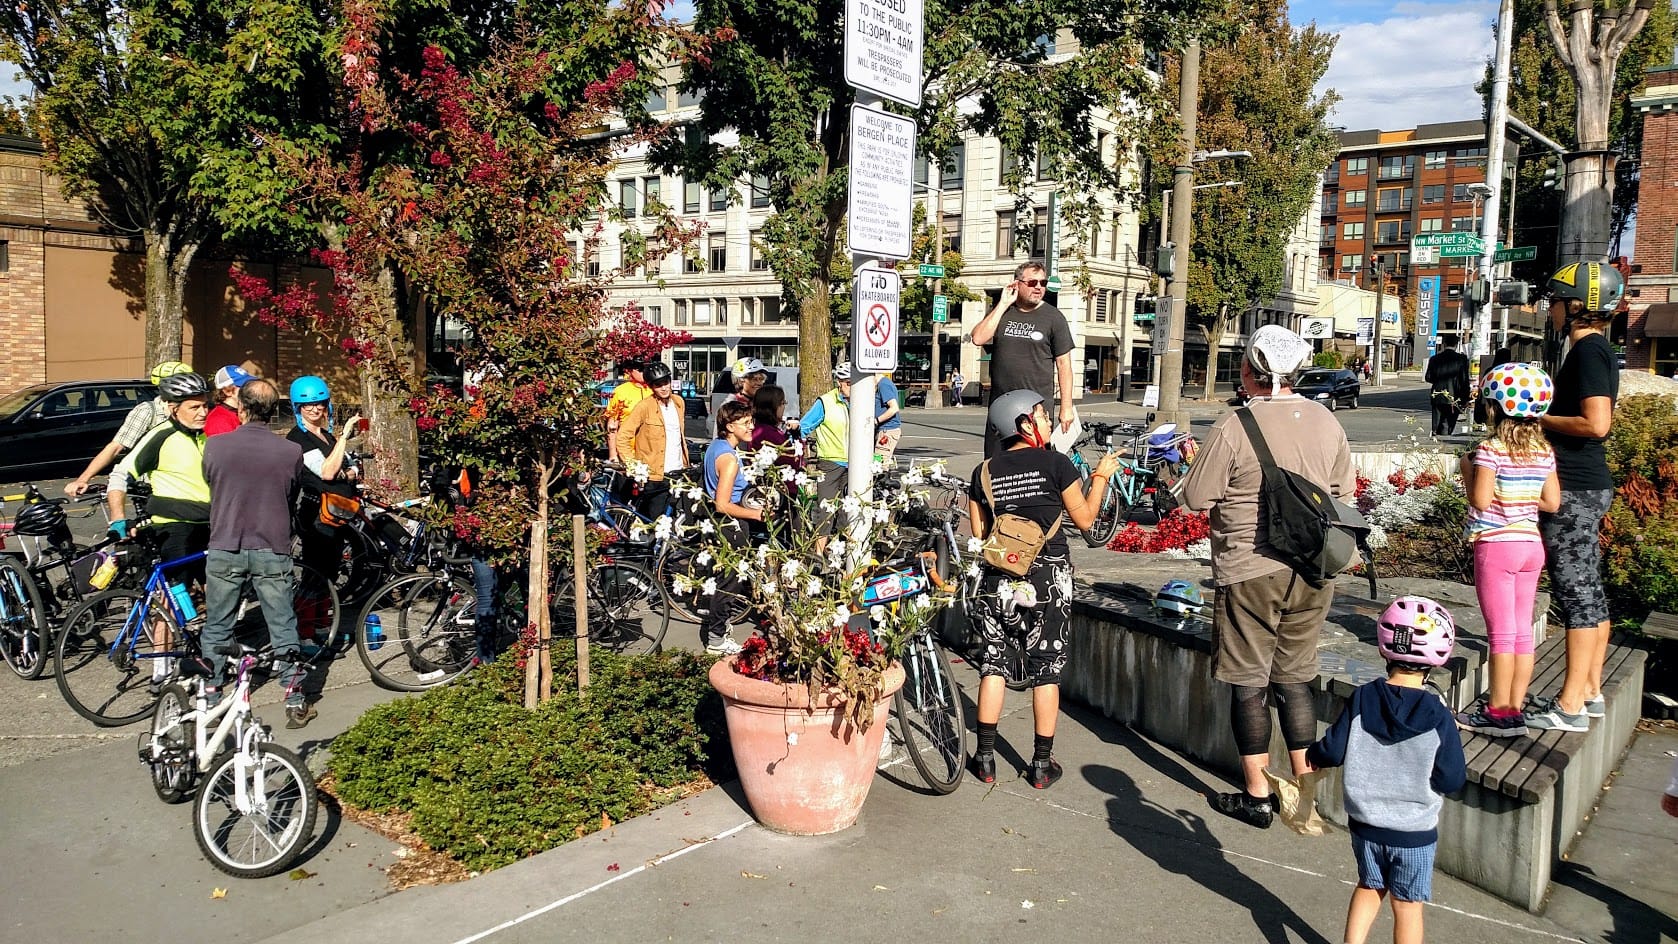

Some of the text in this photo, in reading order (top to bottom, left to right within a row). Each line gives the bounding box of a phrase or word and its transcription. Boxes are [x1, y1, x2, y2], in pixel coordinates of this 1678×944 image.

[875, 0, 906, 14] SED
[860, 2, 912, 35] TO THE PUBLIC
[857, 18, 891, 44] 11:30PM
[897, 35, 913, 53] 4AM
[868, 48, 903, 70] TRESPASSERS
[857, 56, 870, 69] WILL
[870, 61, 878, 72] BE
[879, 64, 912, 84] PROSECUTED
[865, 115, 903, 133] WELCOME TO
[857, 125, 909, 149] BERGEN PLACE
[1415, 237, 1426, 245] NW
[1427, 235, 1457, 245] Market
[1525, 250, 1535, 258] NW
[871, 275, 887, 290] NO
[861, 290, 896, 303] SKATEBOARDS
[1589, 287, 1599, 309] CAUTI
[1159, 301, 1169, 313] NO
[1418, 291, 1432, 336] CHASE
[1006, 320, 1036, 331] HOUSE
[864, 348, 891, 359] ALLOWED
